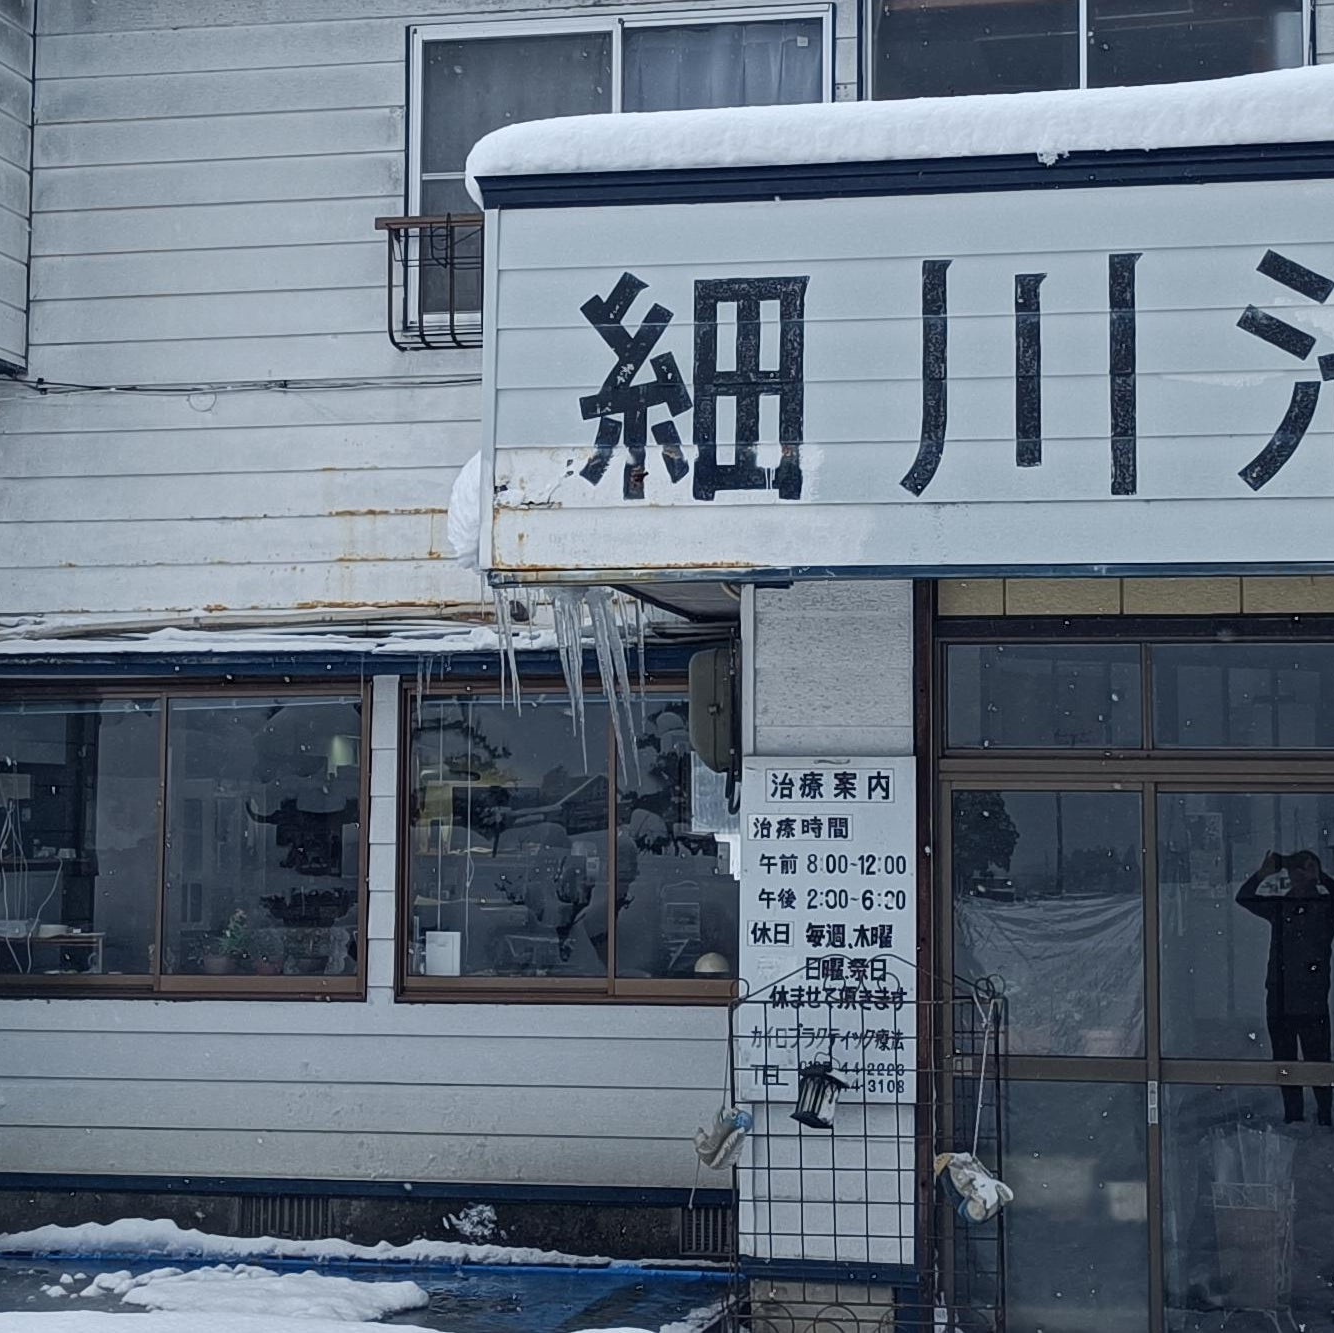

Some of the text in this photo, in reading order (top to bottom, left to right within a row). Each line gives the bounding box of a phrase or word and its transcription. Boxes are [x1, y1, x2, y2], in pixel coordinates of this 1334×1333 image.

[770, 770, 891, 800] 治療案内
[752, 816, 850, 839] 治療時間
[759, 853, 798, 875] 午前
[758, 888, 797, 909] 午後
[751, 921, 790, 944] 休日
[769, 985, 908, 1011] 休ませて頂きます
[751, 1023, 905, 1051] カイロプラクティック療法
[750, 1064, 789, 1087] TEL
[840, 1078, 905, 1094] 4-3108
